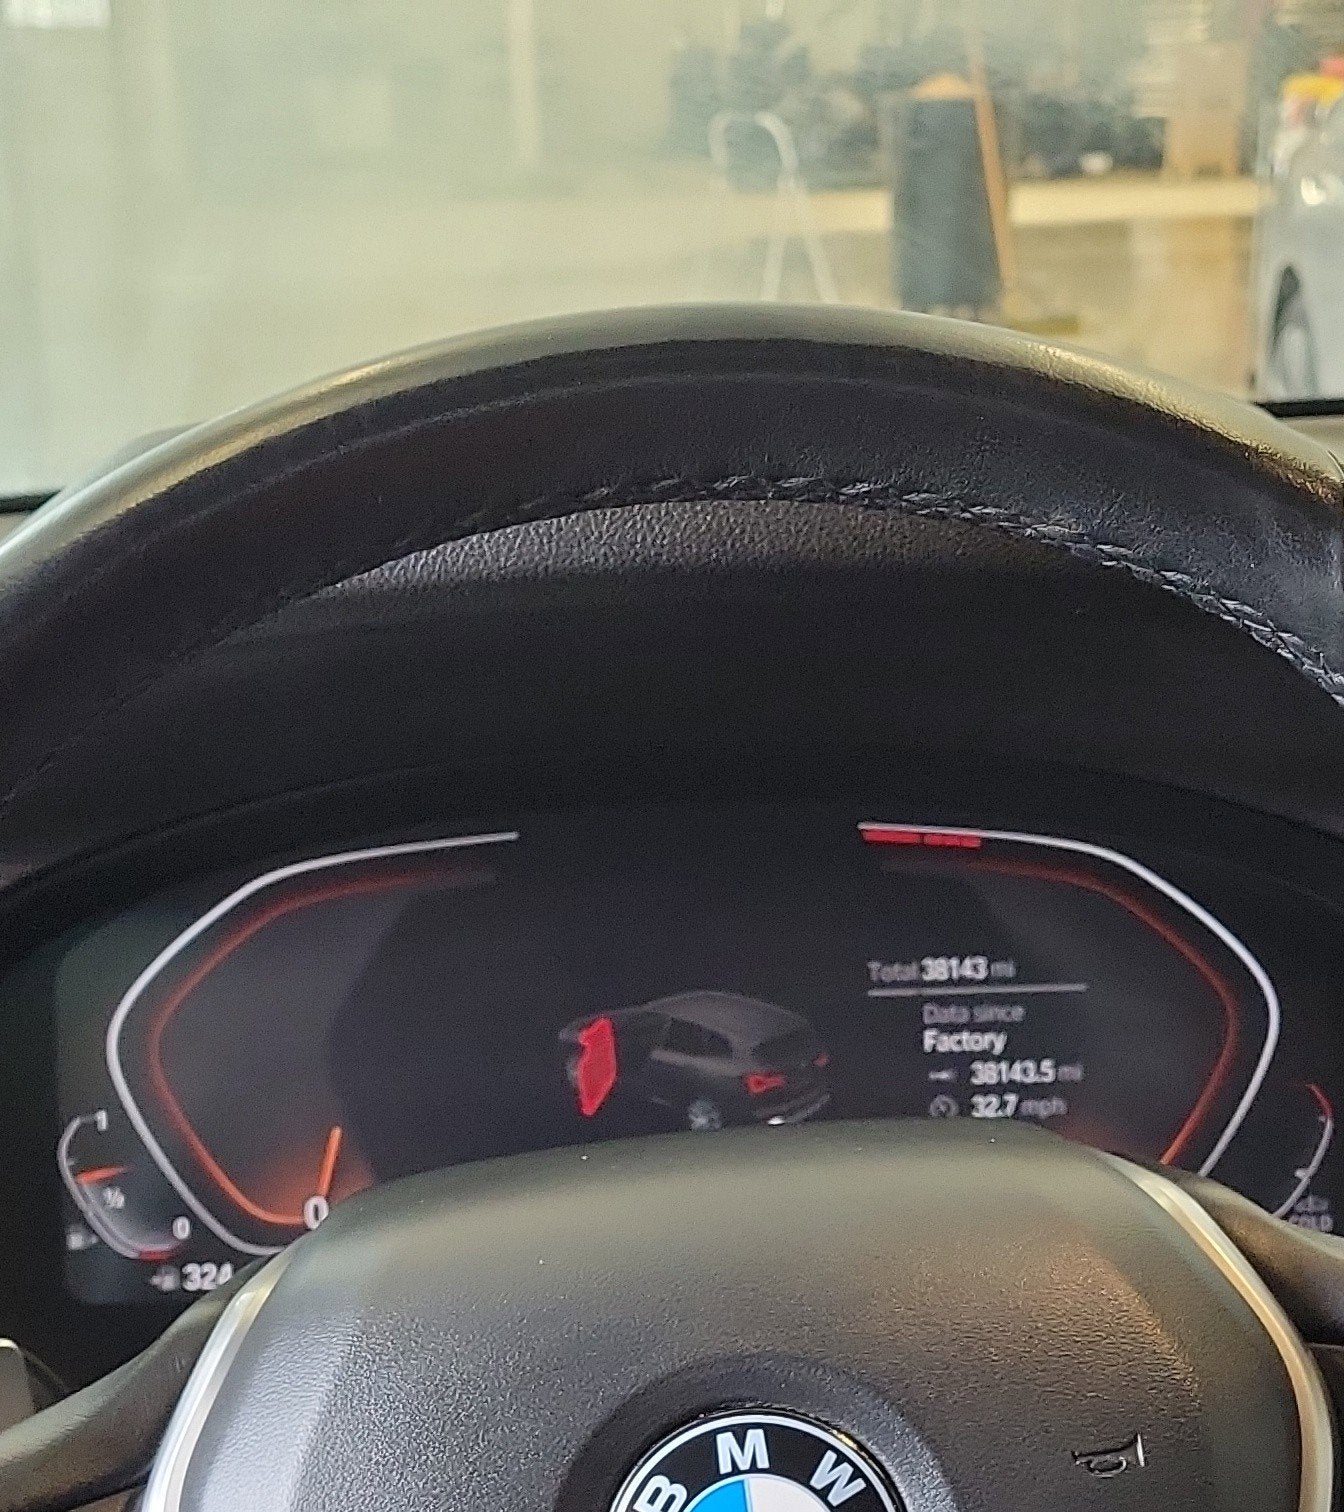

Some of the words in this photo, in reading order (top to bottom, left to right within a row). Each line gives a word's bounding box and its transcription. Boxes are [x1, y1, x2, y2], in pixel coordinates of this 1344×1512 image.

[867, 960, 920, 982] Total
[921, 955, 989, 981] 38143
[991, 960, 1016, 978] mi
[922, 1002, 970, 1024] Data
[973, 1003, 1026, 1023] since
[922, 1028, 1007, 1055] Factory
[970, 1058, 1056, 1085] 38143.5
[971, 1093, 1019, 1118] 32.7
[303, 1195, 330, 1230] 0
[171, 1216, 191, 1240] 0
